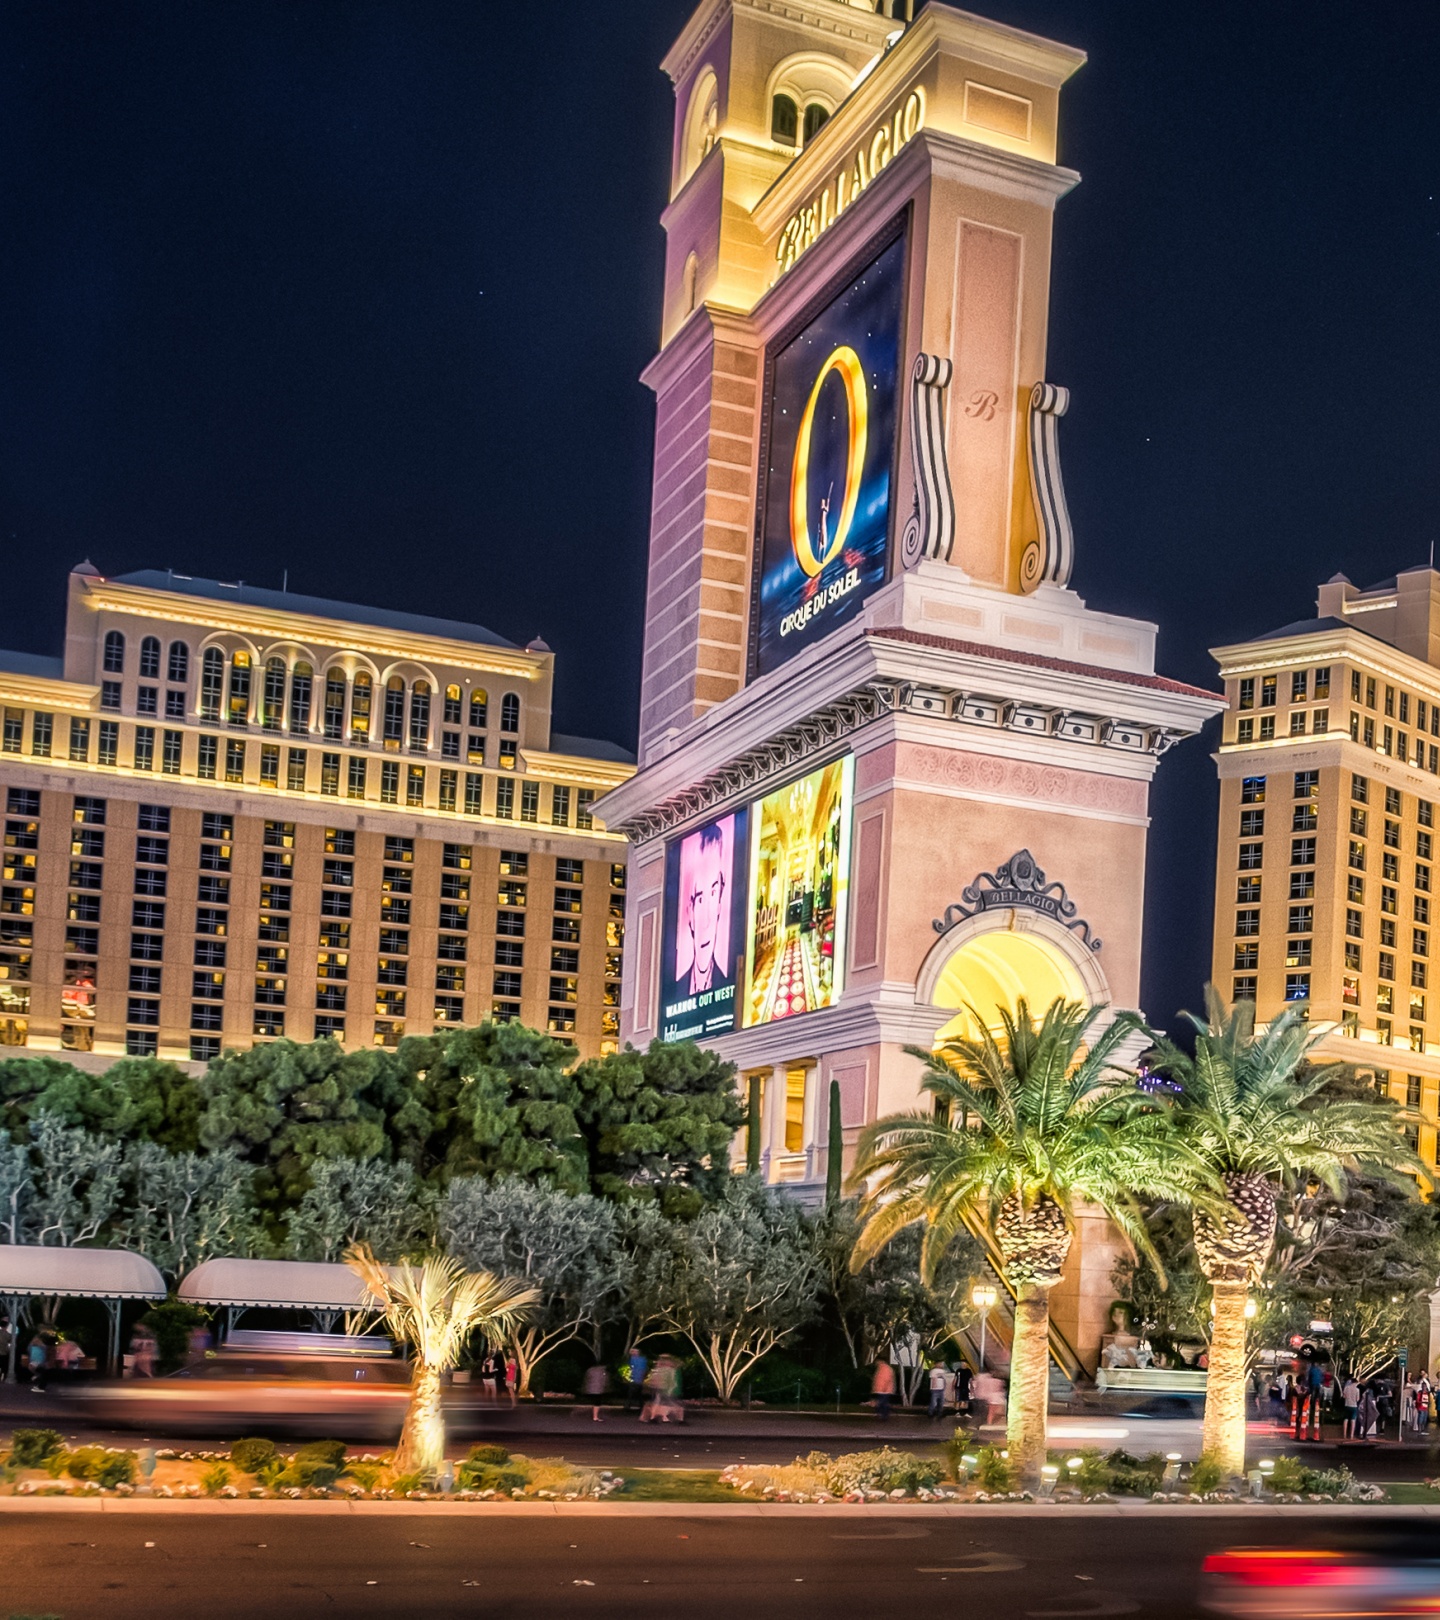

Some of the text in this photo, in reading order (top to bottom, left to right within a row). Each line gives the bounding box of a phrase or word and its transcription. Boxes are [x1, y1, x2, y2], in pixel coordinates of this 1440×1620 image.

[771, 85, 926, 286] BELLAGIO
[780, 567, 861, 637] CIRQUE DU SOLEIL
[992, 891, 1055, 911] BELLAGIO
[699, 992, 713, 1007] OUT
[715, 985, 735, 1002] WEST
